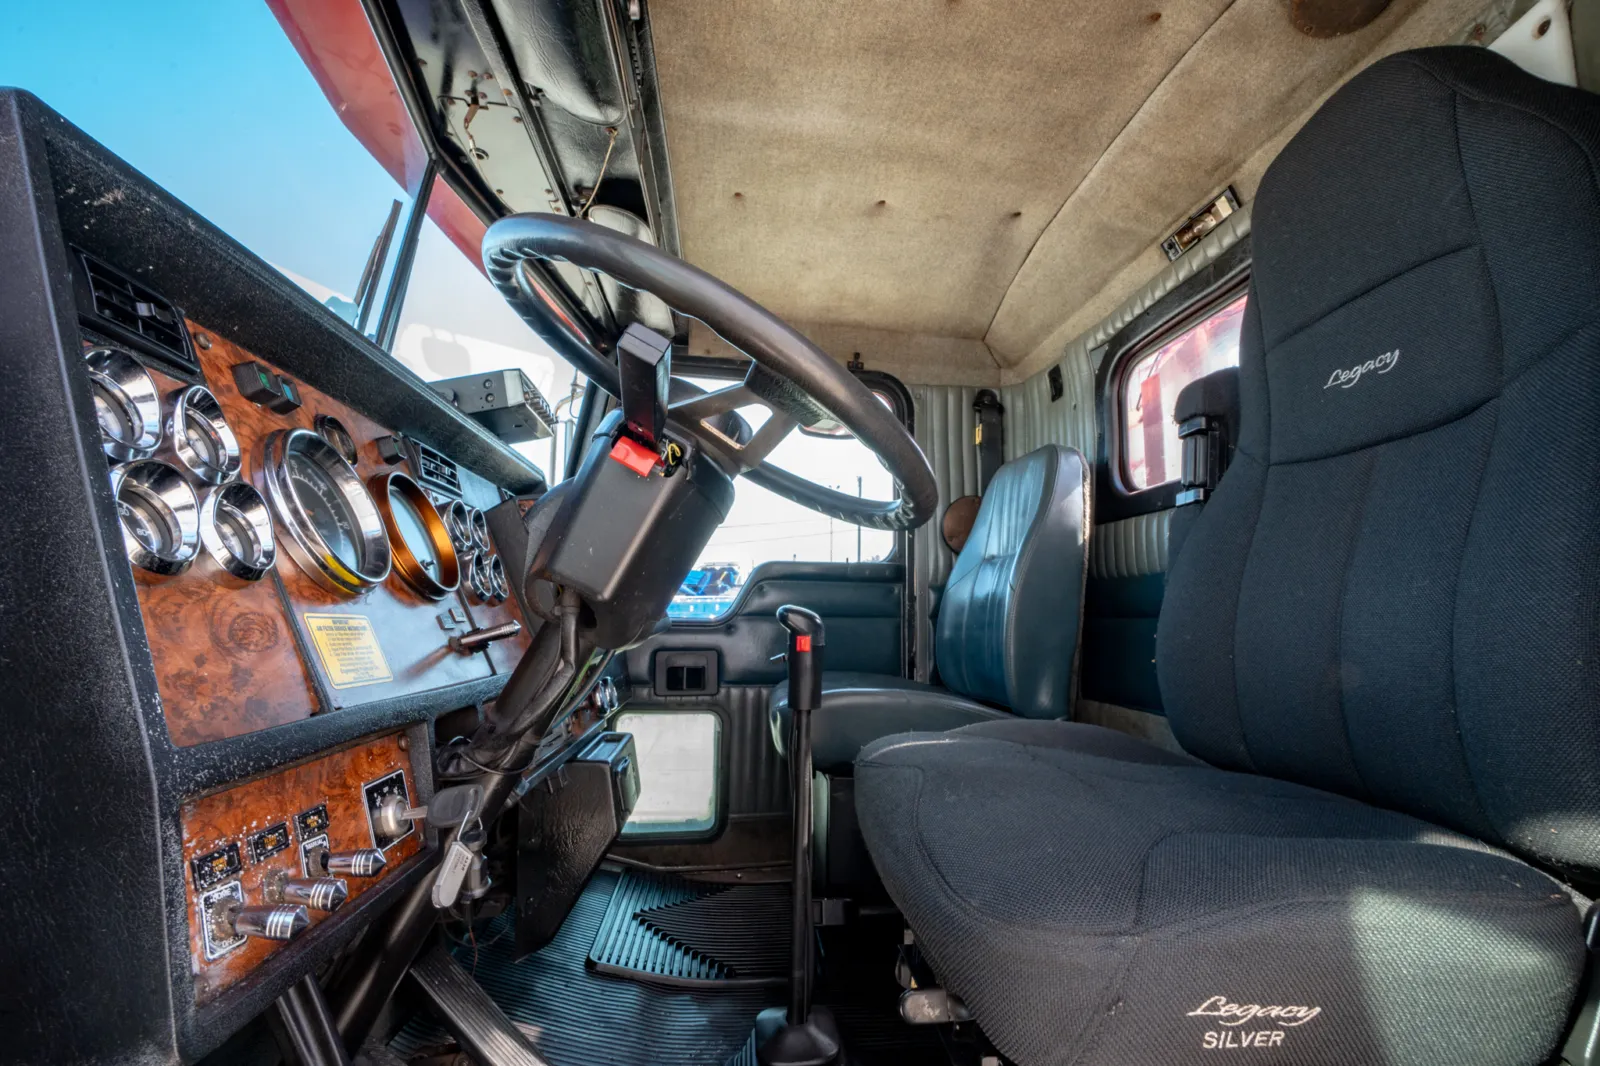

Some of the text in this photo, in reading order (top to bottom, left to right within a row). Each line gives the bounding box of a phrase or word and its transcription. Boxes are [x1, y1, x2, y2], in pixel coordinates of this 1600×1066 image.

[1323, 348, 1400, 389] Legacy
[1186, 995, 1322, 1026] Legacy
[1203, 1031, 1286, 1049] SILVER
